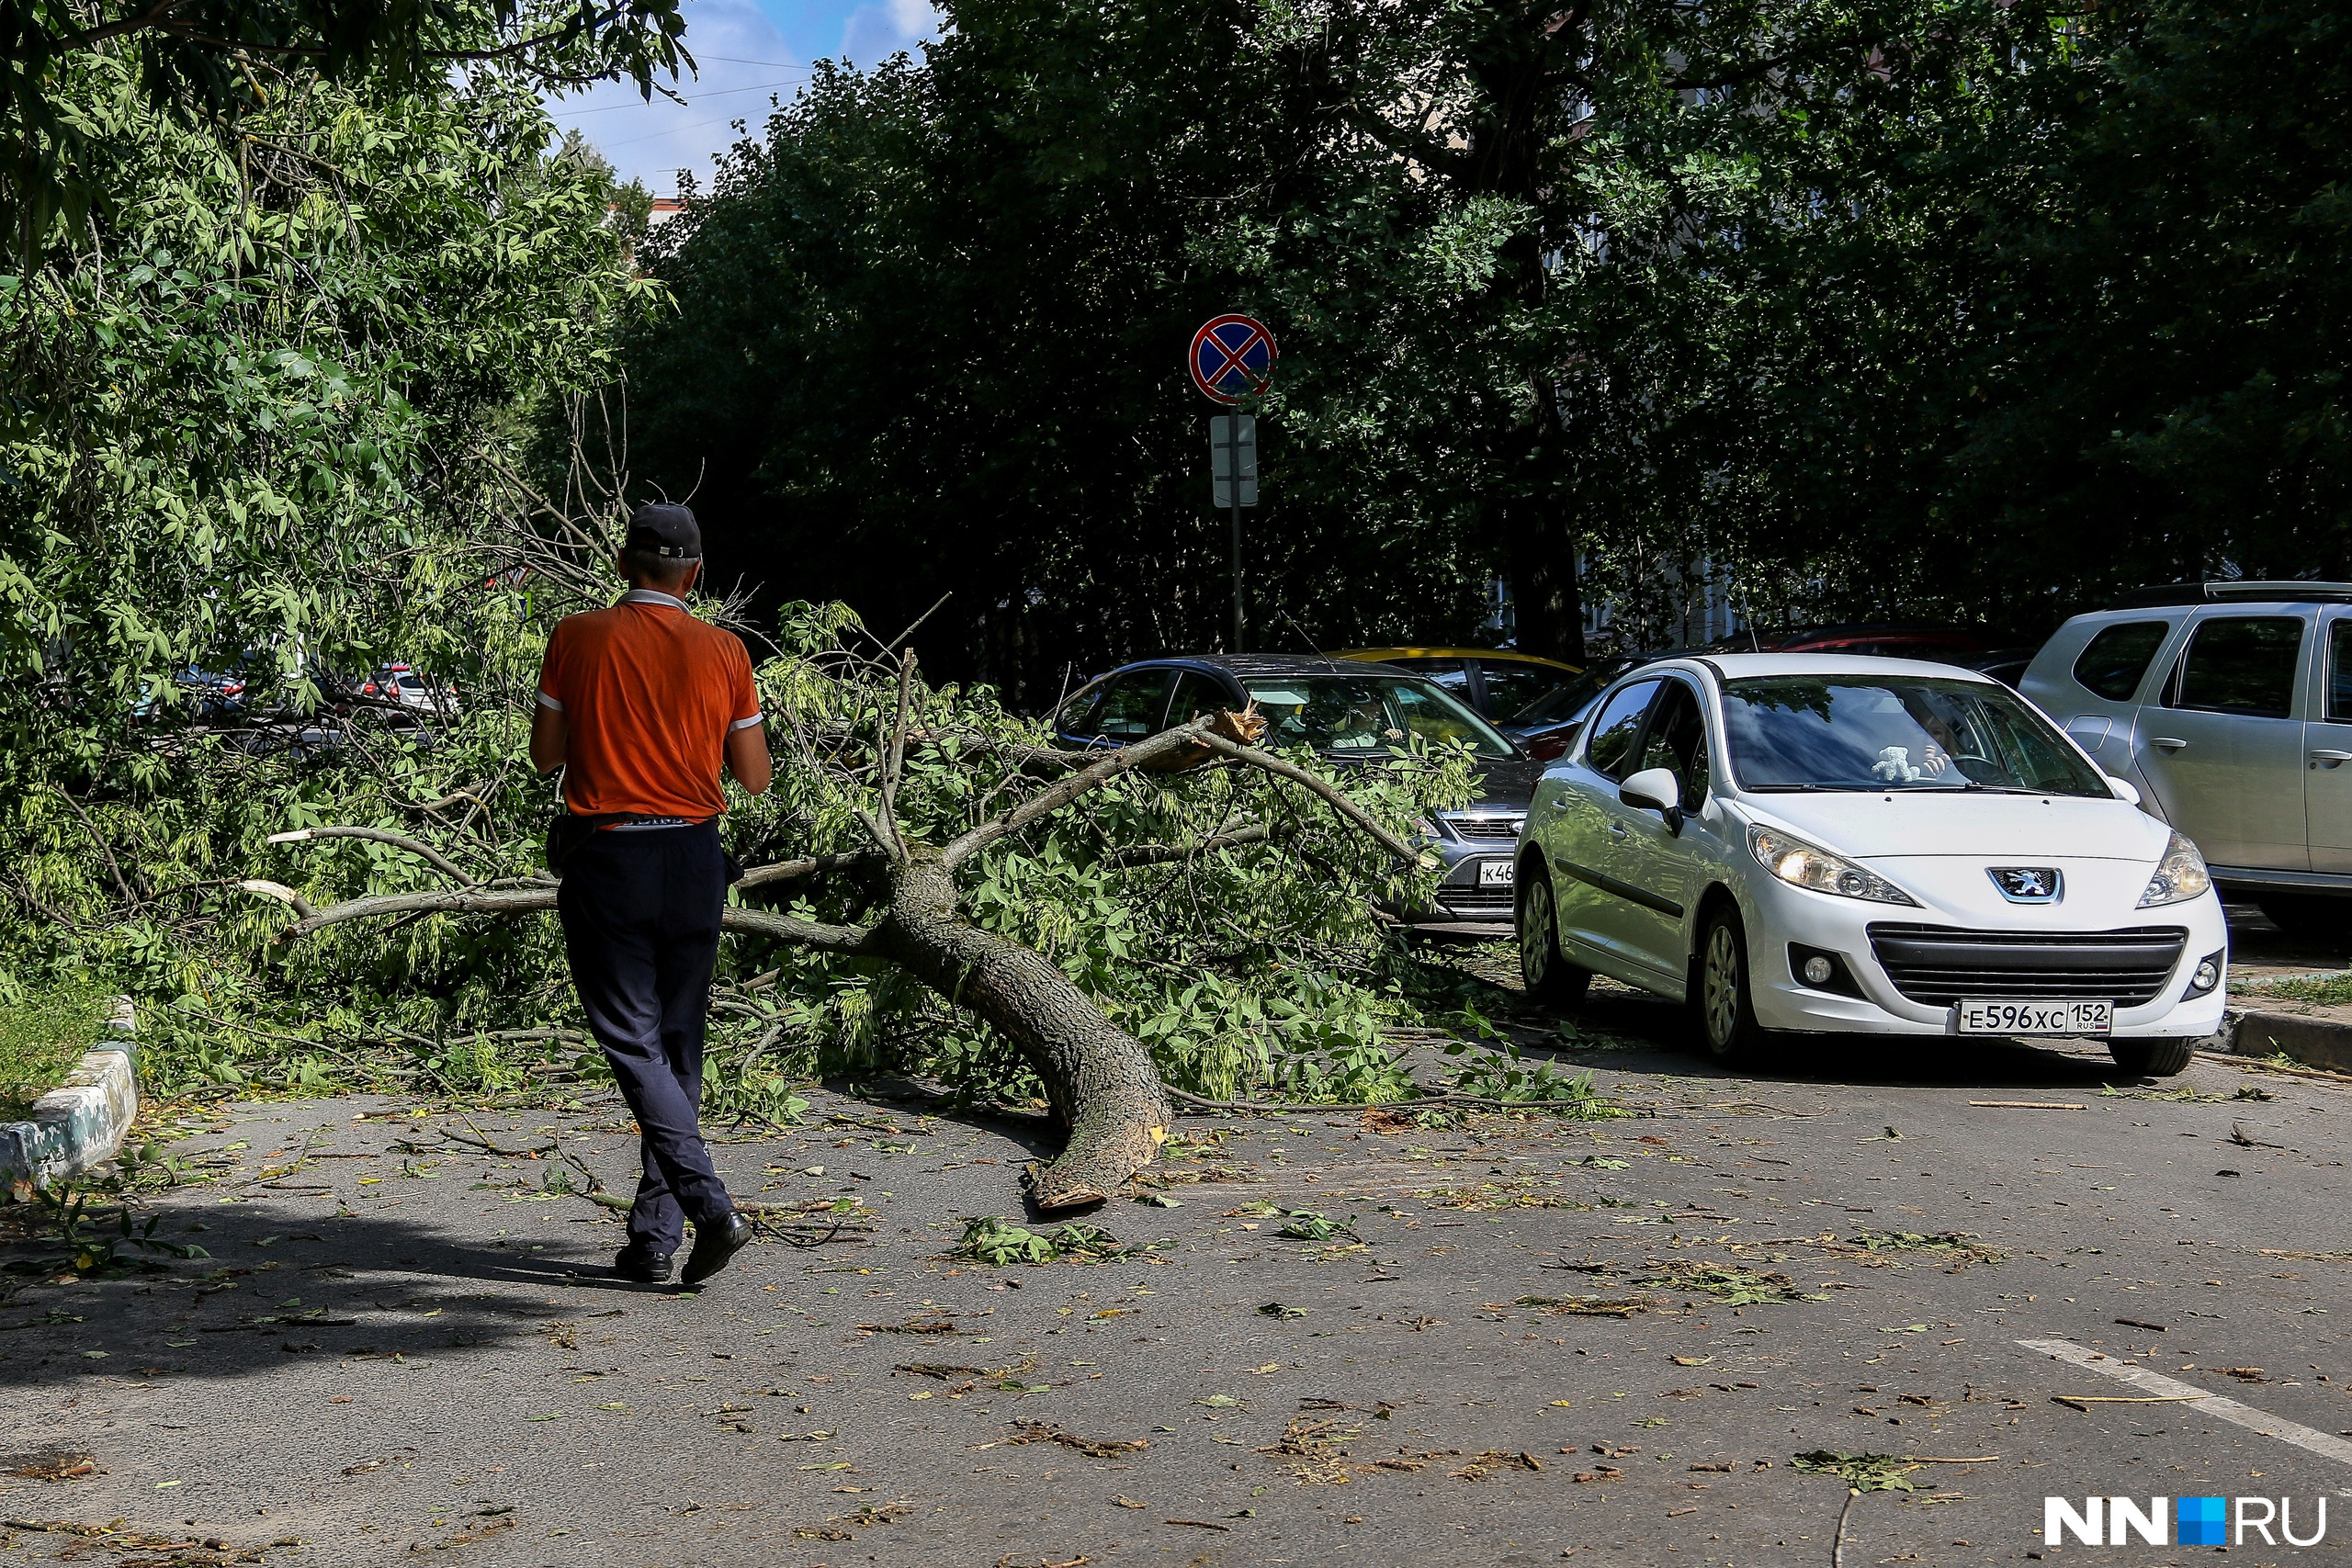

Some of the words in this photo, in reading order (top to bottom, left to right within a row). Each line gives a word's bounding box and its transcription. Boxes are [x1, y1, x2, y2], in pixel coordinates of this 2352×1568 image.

[1969, 1006, 2064, 1029] E596XC
[2071, 1004, 2106, 1022] 152
[2076, 1021, 2095, 1030] RUS
